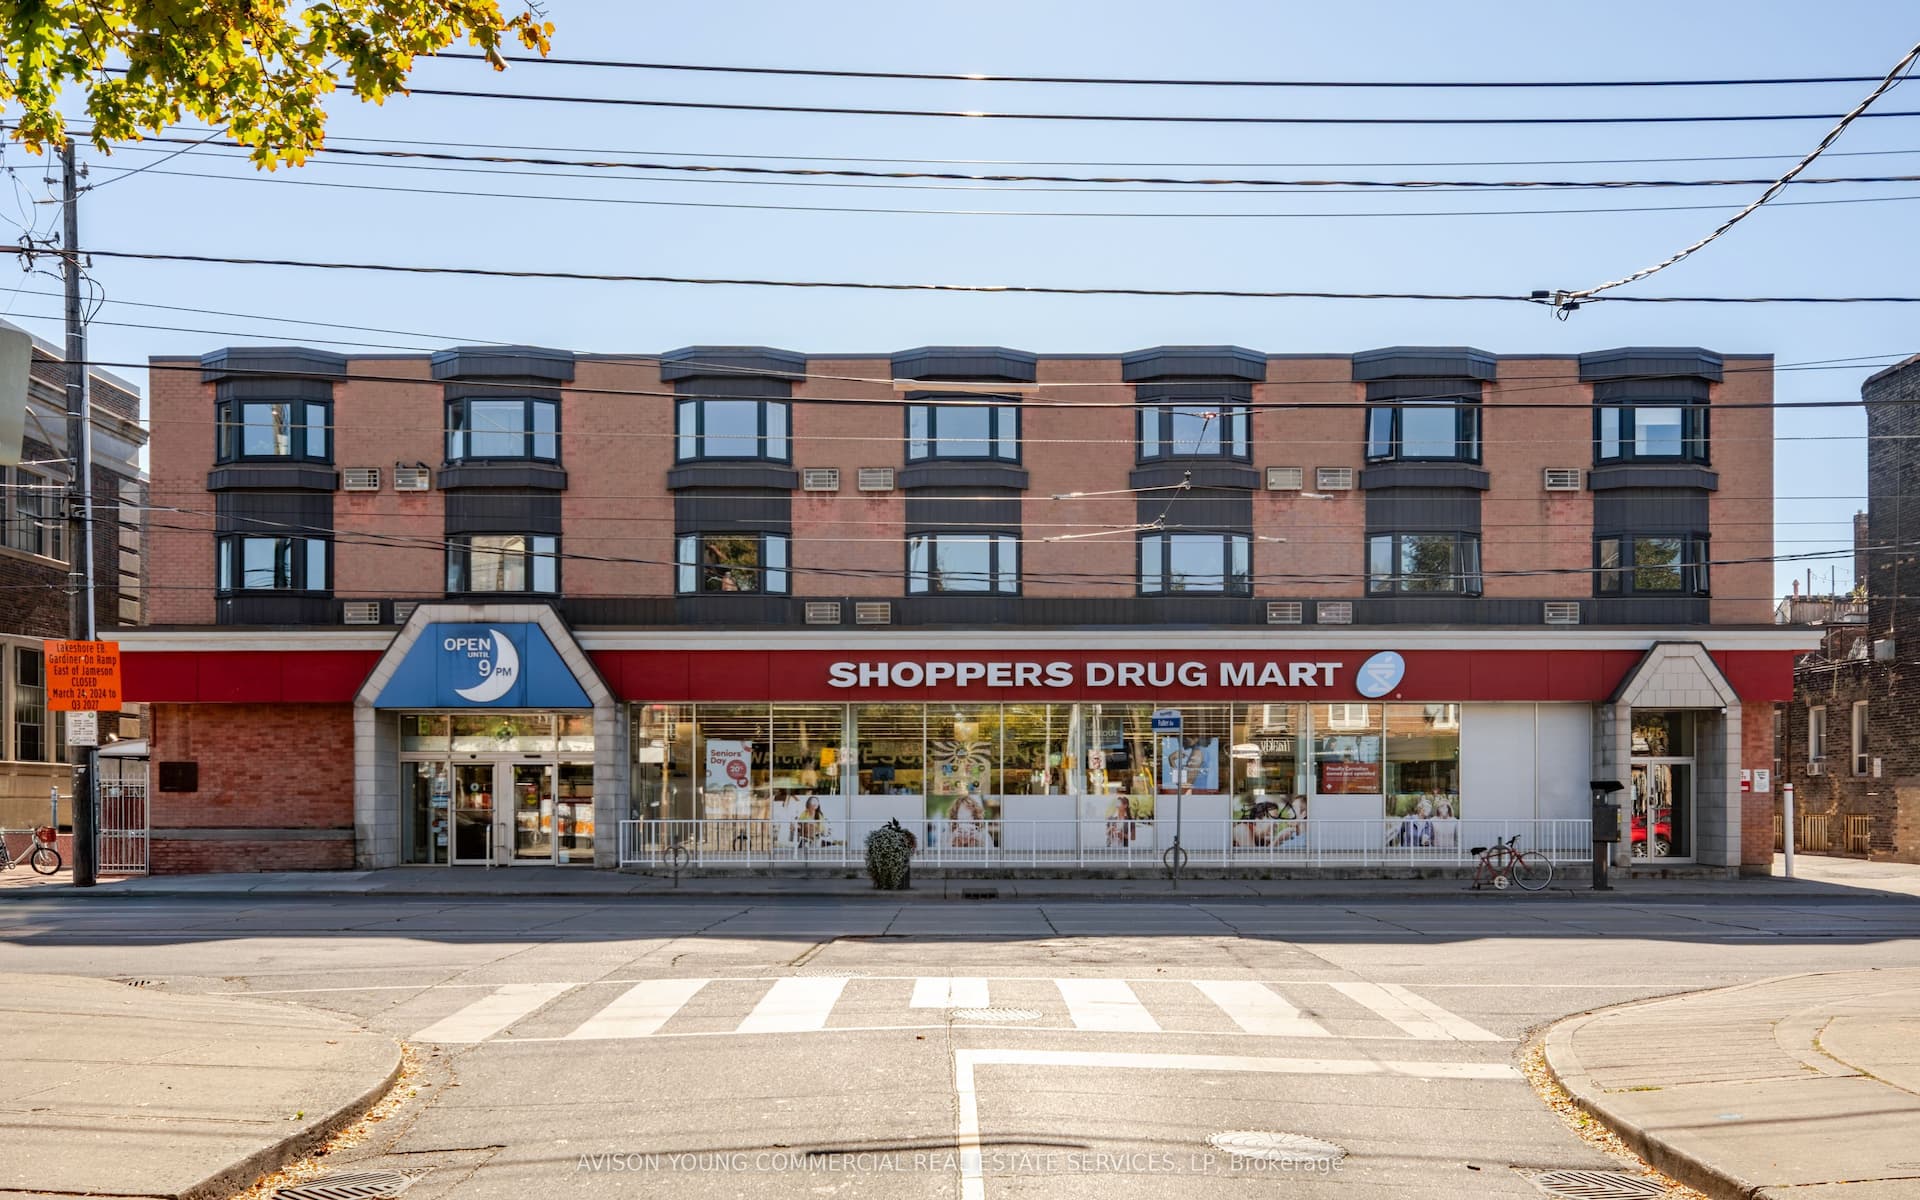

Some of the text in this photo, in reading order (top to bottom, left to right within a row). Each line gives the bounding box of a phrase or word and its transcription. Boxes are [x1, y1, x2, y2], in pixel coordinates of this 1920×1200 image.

[57, 643, 94, 653] Lakeshore
[444, 638, 491, 651] OPEN
[49, 654, 117, 667] Gardiner On Ramp
[54, 666, 114, 676] East of Jameson
[478, 659, 512, 677] 9 PM
[827, 661, 1343, 688] SHOPPERS DRUG MART
[71, 677, 97, 687] CLOSED
[53, 688, 75, 699] March
[90, 689, 107, 699] 2024
[109, 689, 117, 699] to
[72, 700, 99, 710] Q3 2027
[711, 757, 726, 766] Day
